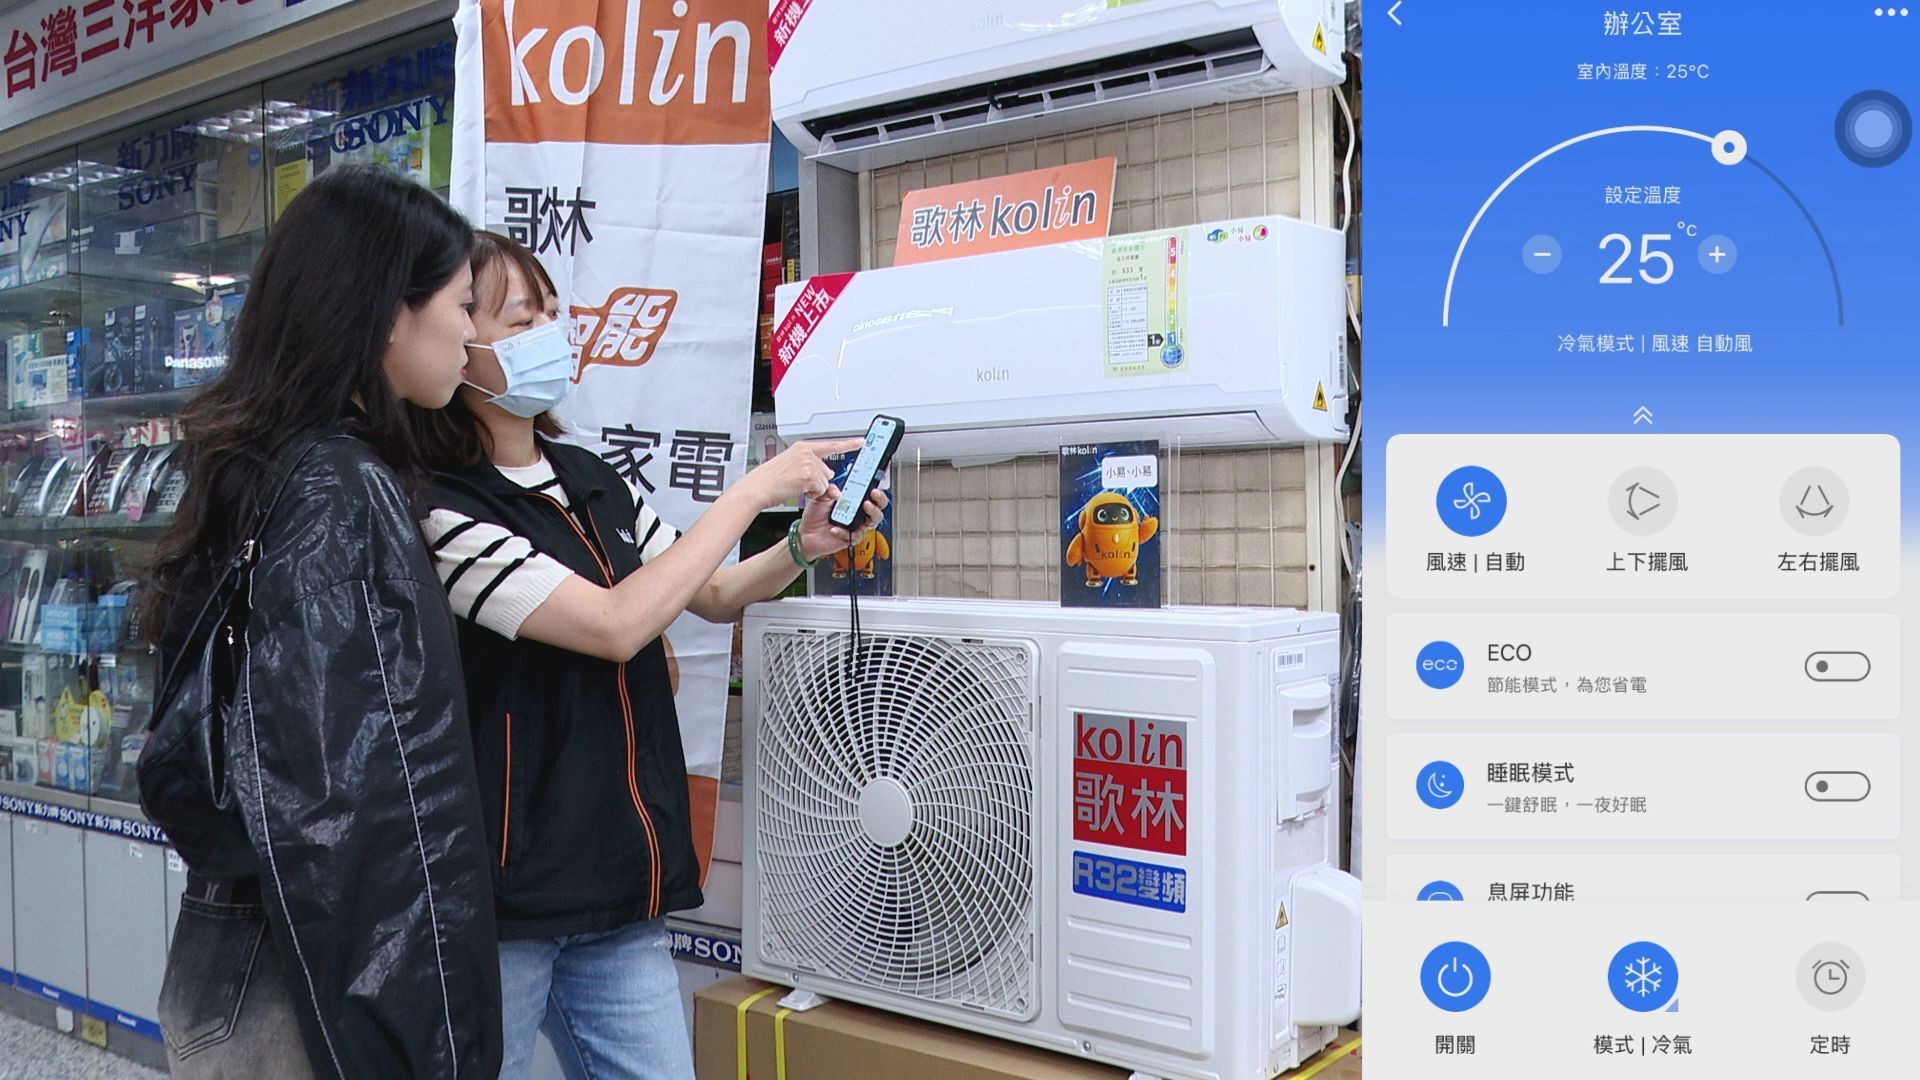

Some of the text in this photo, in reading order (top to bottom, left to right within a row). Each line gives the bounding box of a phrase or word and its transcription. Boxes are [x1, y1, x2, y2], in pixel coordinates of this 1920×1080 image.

[1603, 10, 1682, 37] 辦公室
[4, 0, 256, 98] 台灣三洋
[503, 0, 750, 106] kolin
[118, 164, 198, 210] SONY
[1604, 185, 1681, 205] 設定溫度
[911, 186, 1097, 250] 歌林 kolin
[1598, 232, 1675, 285] 25
[794, 284, 817, 317] NEW
[777, 287, 836, 367] 新機上市
[1558, 334, 1634, 353] 冷氣模式
[1651, 334, 1689, 353] 風速
[1697, 334, 1753, 353] 自動風
[976, 365, 1010, 383] kolin
[1077, 445, 1097, 455] kolin
[601, 424, 735, 502] 家電
[1106, 465, 1152, 479] 小易、小易
[1101, 549, 1131, 560] kolin
[1426, 552, 1467, 572] 風速
[1486, 552, 1525, 572] 自動
[1605, 552, 1689, 572] 上下擺風
[1777, 552, 1860, 572] 左右擺風
[1487, 643, 1533, 662] ECO
[1487, 675, 1647, 694] 節能模式，為您省電
[1076, 714, 1183, 768] kolin
[1487, 762, 1575, 784] 睡眠模式
[1076, 771, 1185, 842] 歌林
[3, 797, 35, 814] SONY
[60, 807, 96, 827] SONY
[123, 820, 161, 841] SONY
[1075, 857, 1185, 905] R32變頻
[1487, 881, 1575, 901] 息屏功能
[1435, 1035, 1476, 1055] 開關
[1593, 1035, 1635, 1055] 模式
[1651, 1035, 1693, 1055] 冷氣
[1809, 1035, 1851, 1055] 定時
